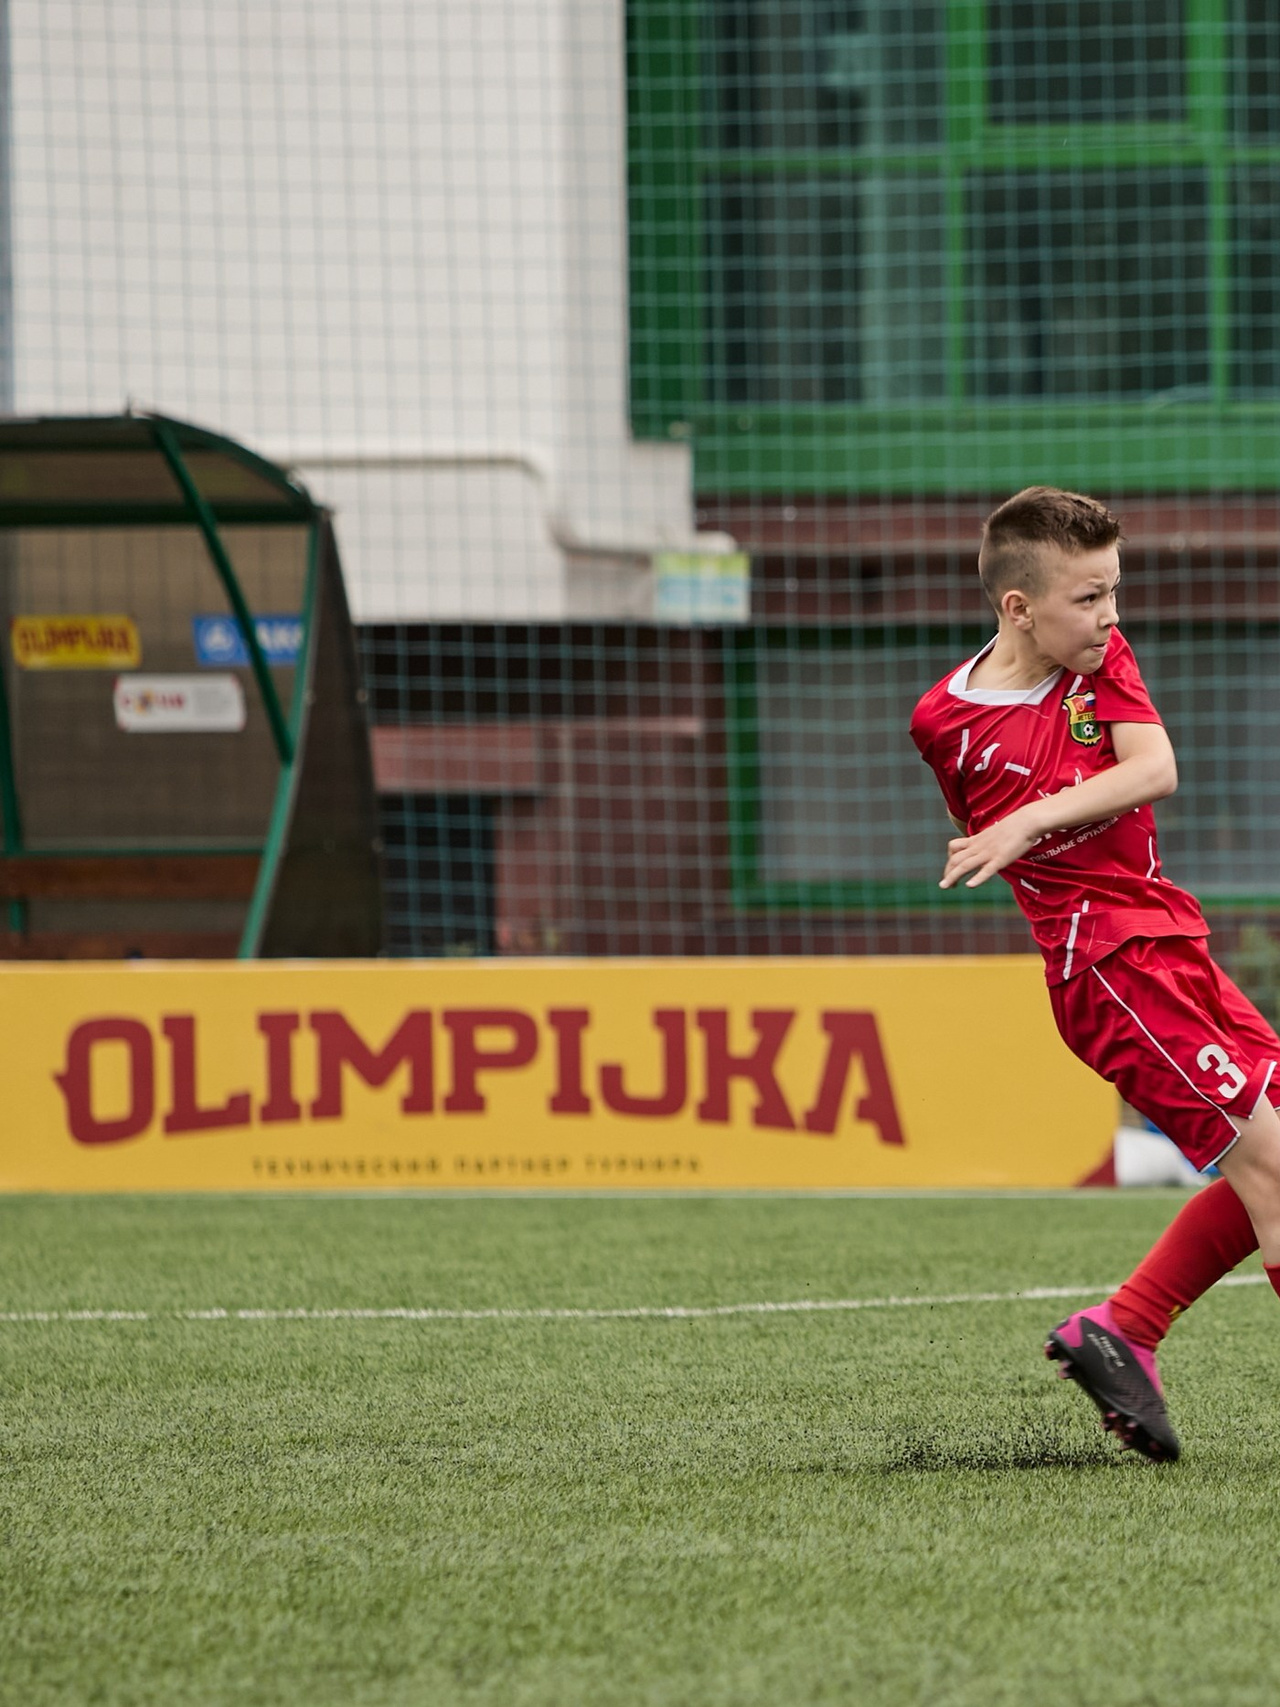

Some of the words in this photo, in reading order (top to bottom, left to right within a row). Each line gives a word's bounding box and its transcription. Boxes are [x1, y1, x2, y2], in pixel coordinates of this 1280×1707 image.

[53, 1008, 907, 1147] OLIMPIJKA
[1196, 1043, 1248, 1100] 3
[453, 1155, 571, 1176] ПАРТНЕР
[585, 1154, 702, 1175] ТУРНИРА
